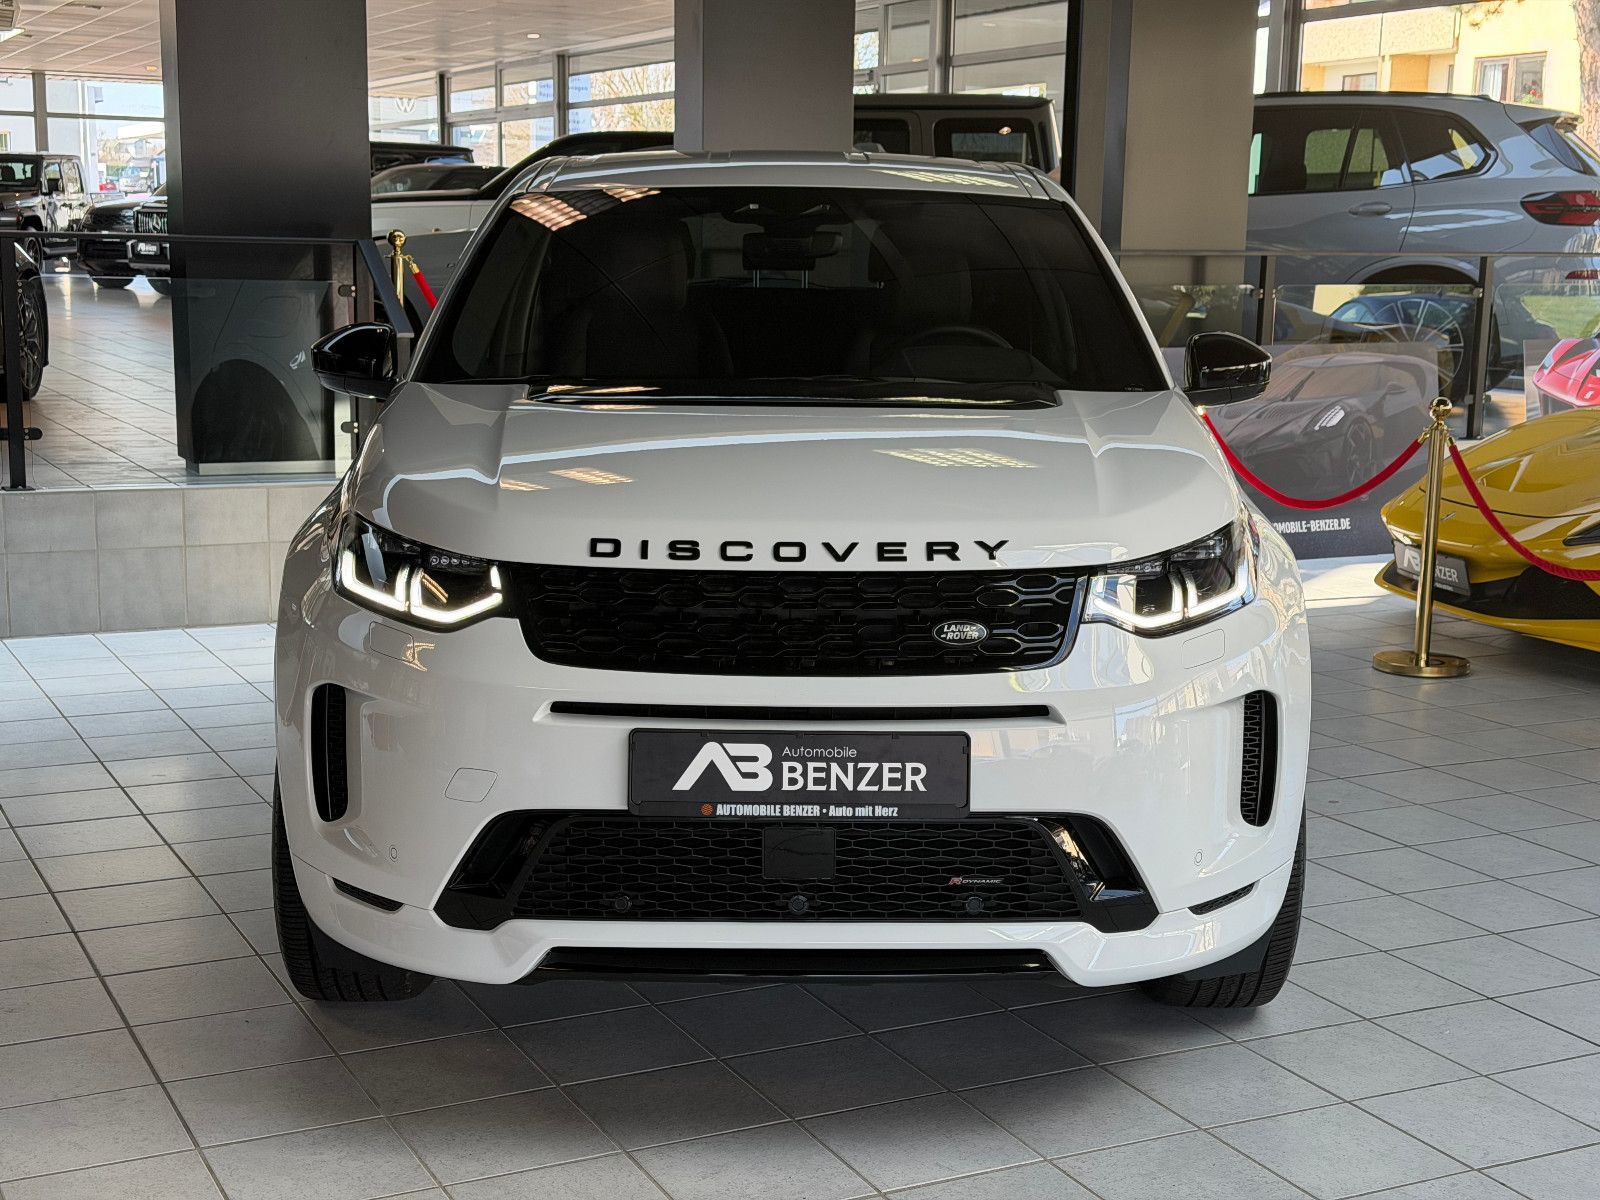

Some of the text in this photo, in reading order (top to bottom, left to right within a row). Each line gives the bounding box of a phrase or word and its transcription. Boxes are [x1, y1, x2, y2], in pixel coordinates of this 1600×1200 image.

[1273, 518, 1351, 534] OMOBILE-BENZER.DE
[590, 537, 1009, 562] DISCOVERY
[1434, 565, 1459, 583] NZER
[782, 745, 857, 759] Automobile
[781, 761, 928, 793] BENZER
[716, 803, 899, 817] AUTOMOBILE BENZER Auto mit Herz
